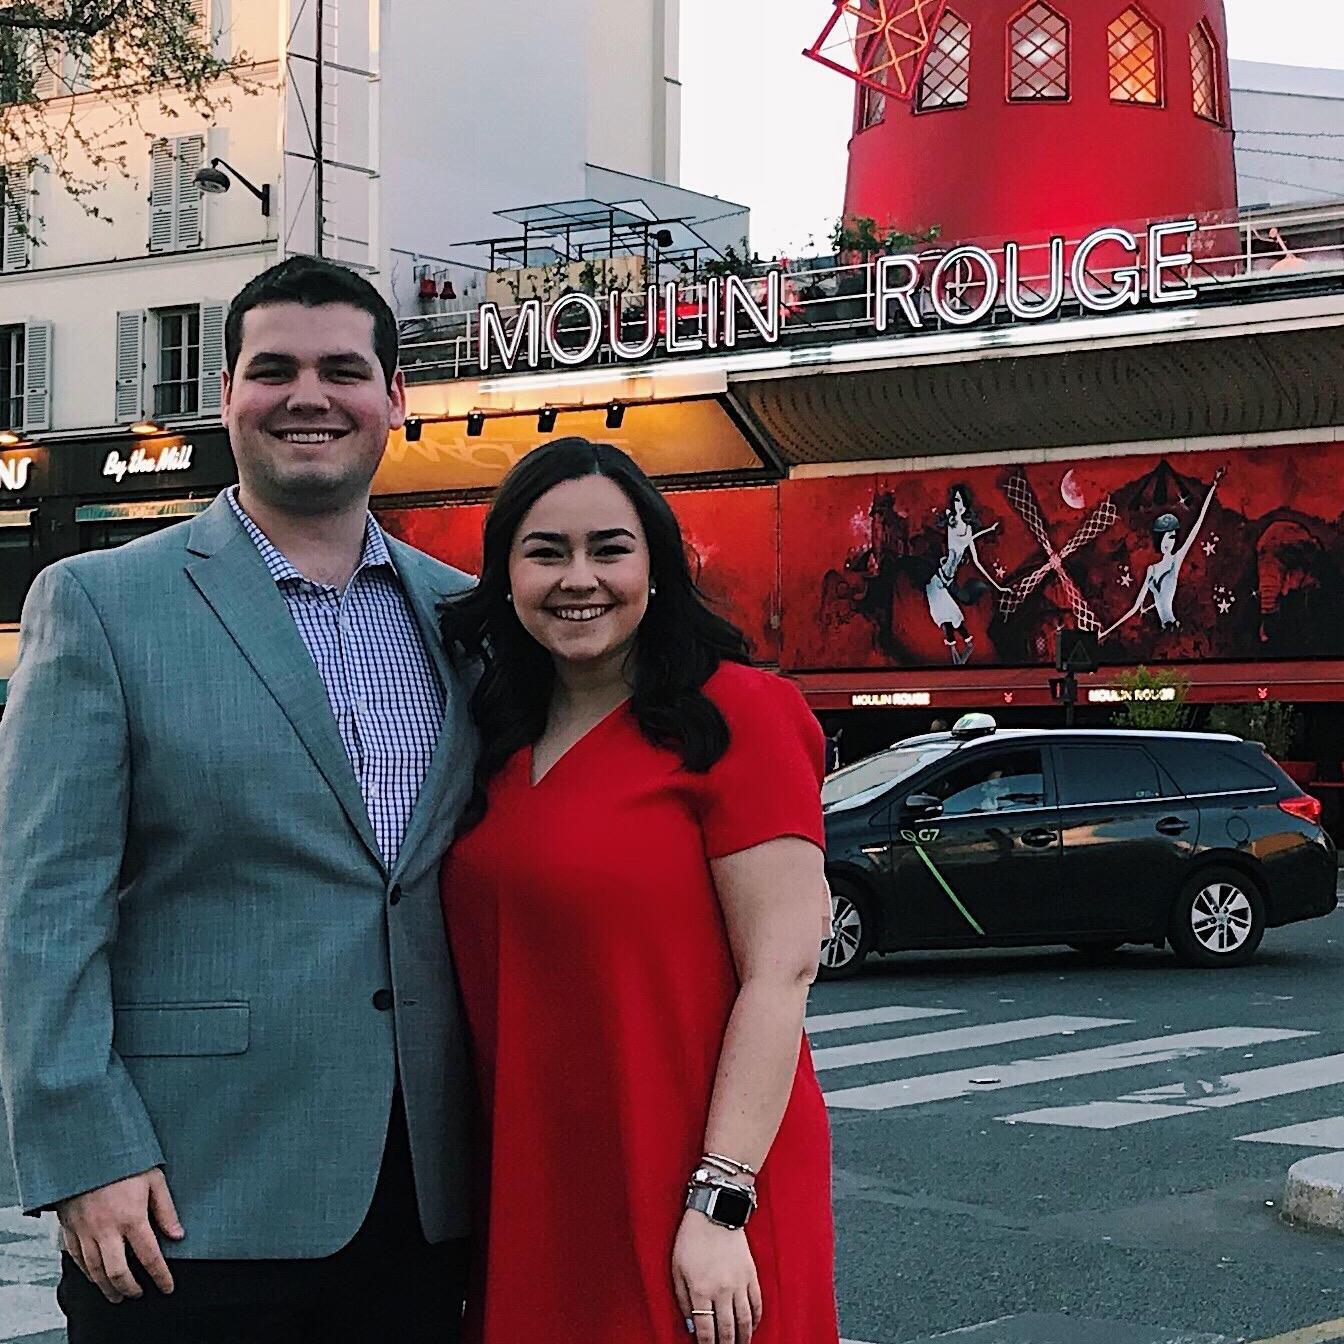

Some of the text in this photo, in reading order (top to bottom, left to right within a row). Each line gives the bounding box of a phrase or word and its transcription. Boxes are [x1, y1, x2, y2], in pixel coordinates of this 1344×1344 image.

[477, 218, 1199, 371] MOULIN ROUGE
[103, 450, 127, 483] By
[155, 444, 193, 472] Mill
[852, 694, 892, 706] MOULIN
[918, 828, 940, 841] G7
